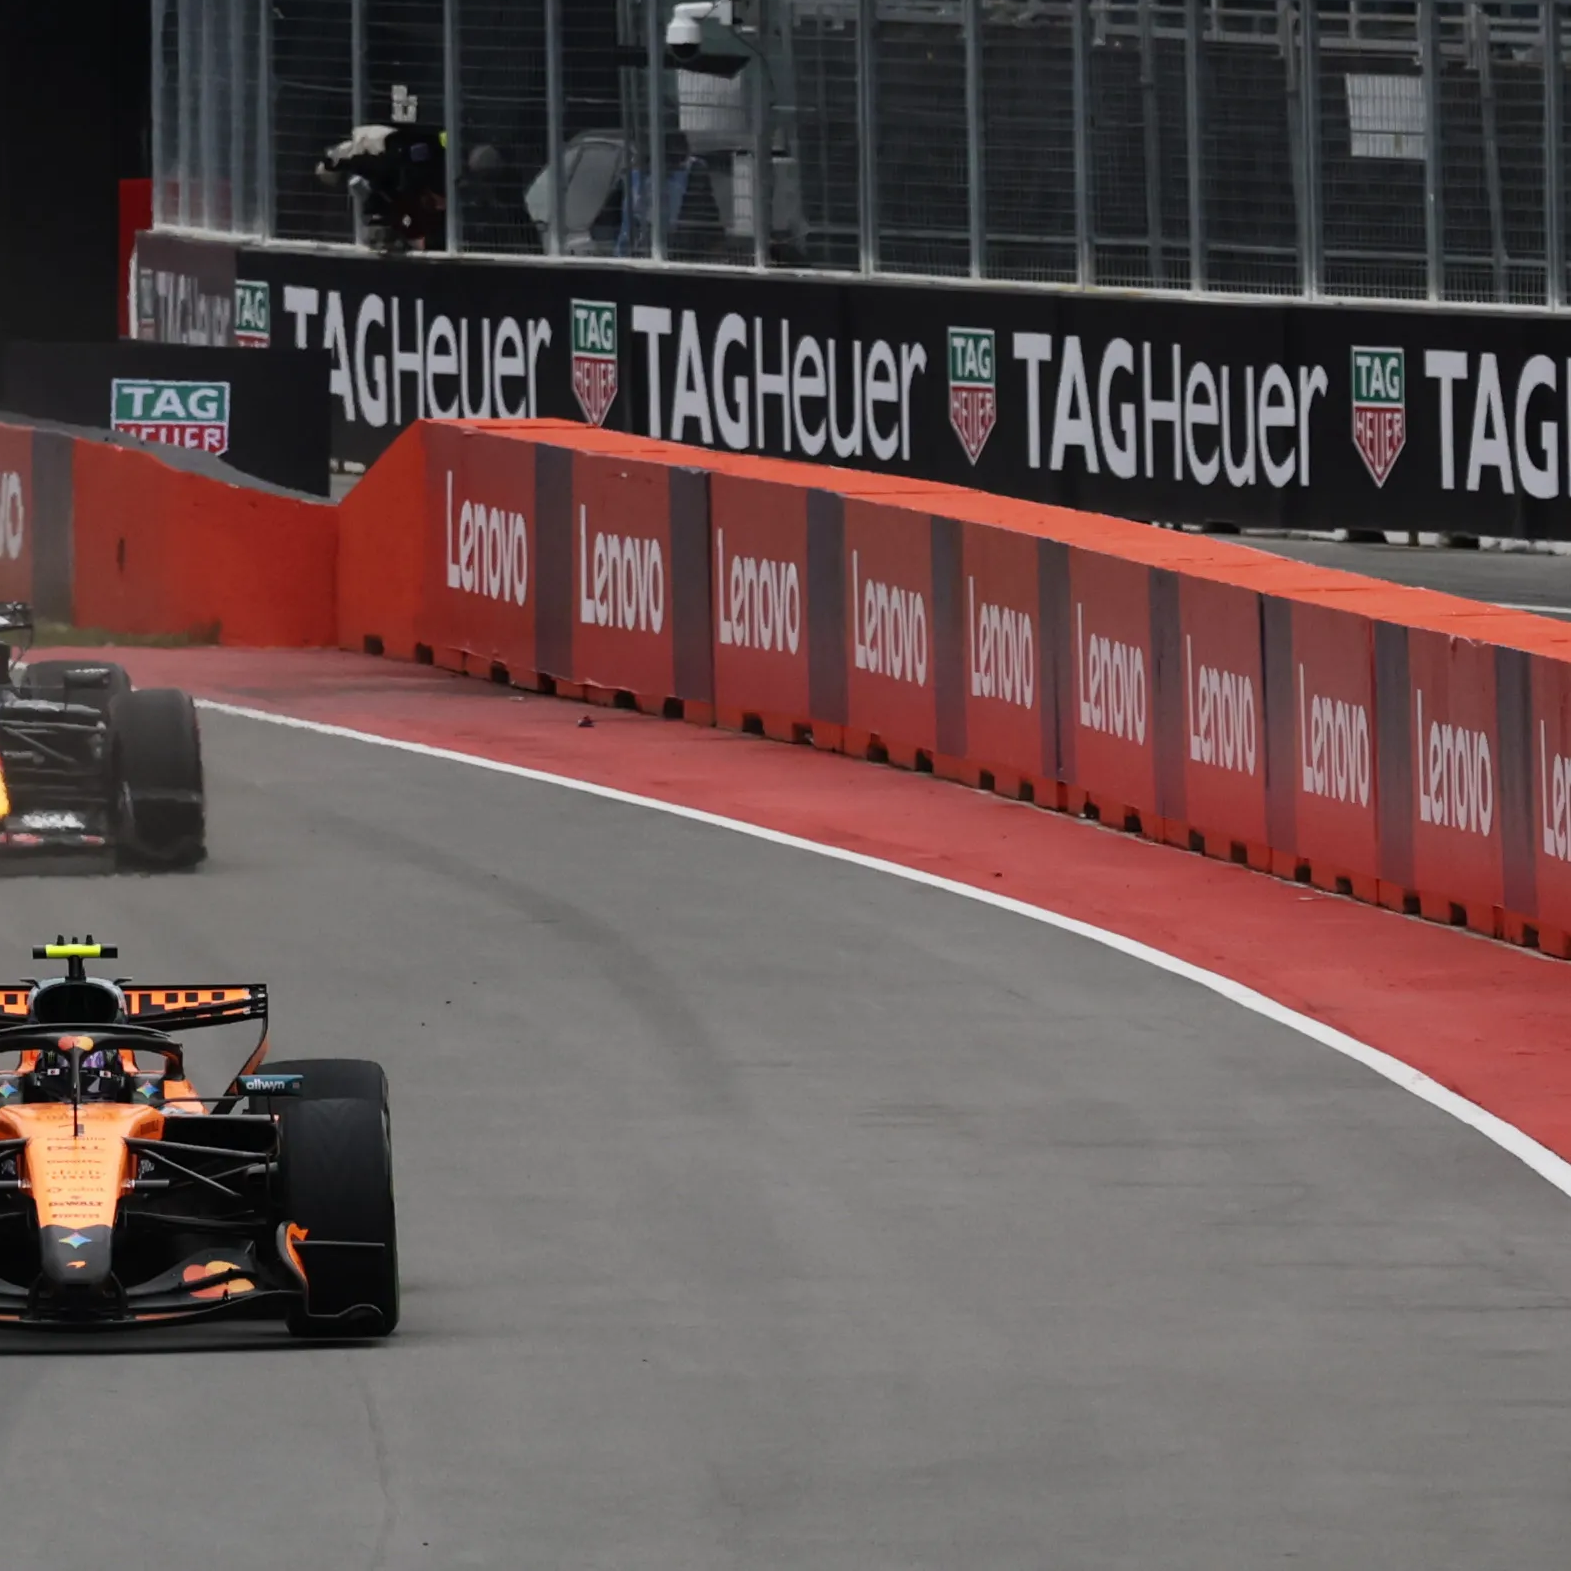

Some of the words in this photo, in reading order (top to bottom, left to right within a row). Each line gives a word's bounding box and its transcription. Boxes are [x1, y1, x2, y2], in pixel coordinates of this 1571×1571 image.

[575, 308, 613, 351] TAG
[953, 336, 991, 380] TAG
[1356, 355, 1401, 400] TAG
[118, 425, 222, 452] EUER
[121, 386, 220, 420] TAG
[1355, 408, 1404, 477] HEUER
[1423, 349, 1571, 500] TAG
[446, 470, 528, 606] Lenovo
[580, 504, 664, 634] Lenovo
[717, 528, 800, 655] Lenovo
[852, 550, 927, 686] Lenovo
[969, 576, 1034, 710] Lenovo
[1077, 602, 1146, 746] Lenovo
[1186, 634, 1256, 775] Lenovo
[1299, 663, 1370, 807] Lenovo
[1417, 689, 1493, 837] Lenovo
[246, 1078, 285, 1093] allwyn
